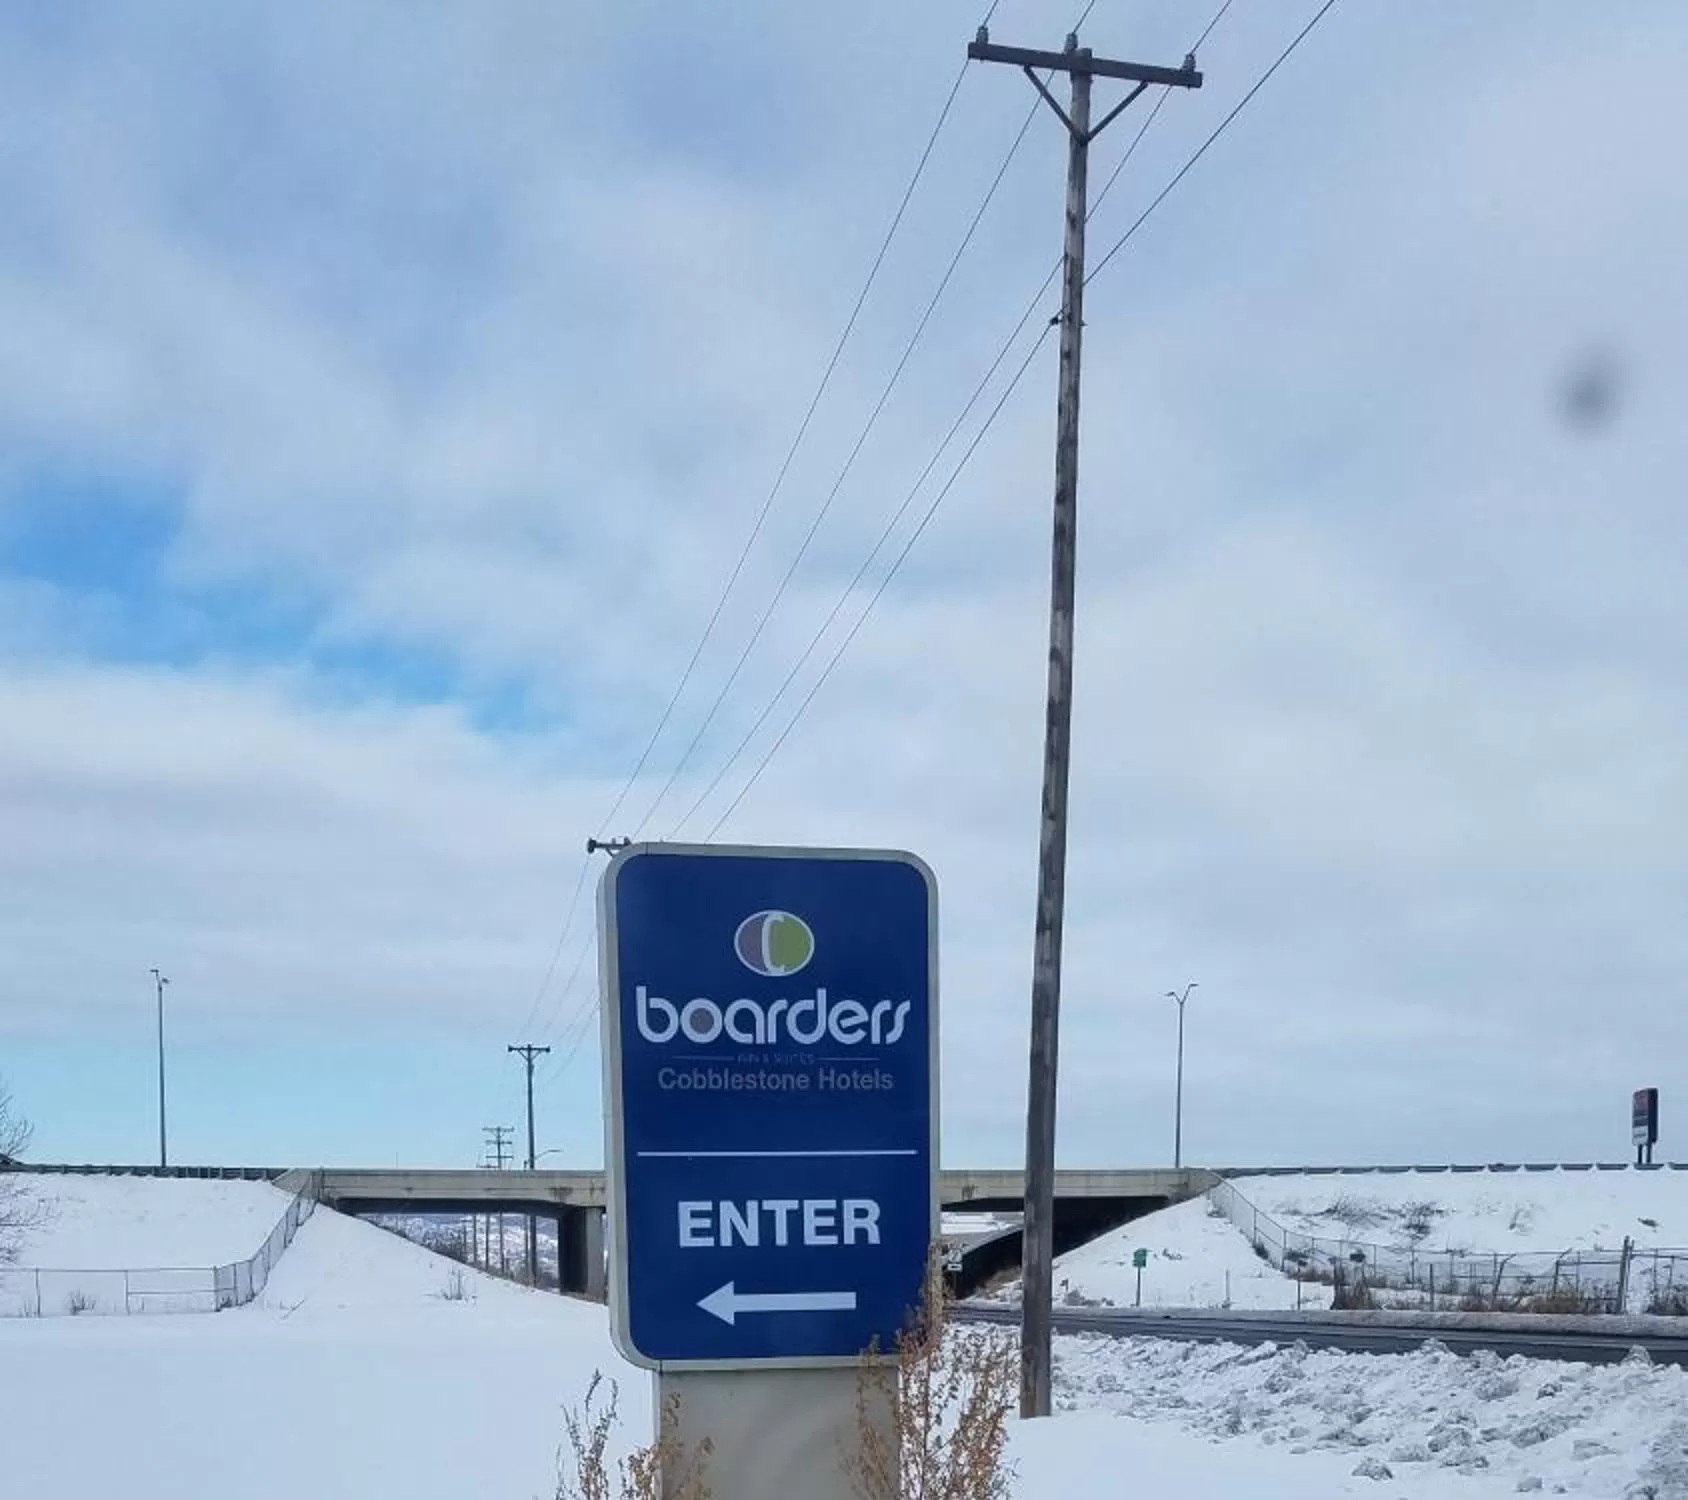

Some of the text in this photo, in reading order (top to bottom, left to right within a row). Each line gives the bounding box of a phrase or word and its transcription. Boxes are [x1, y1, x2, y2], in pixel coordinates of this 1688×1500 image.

[636, 986, 911, 1045] boarders
[658, 1067, 894, 1091] Cobblestone Hotels
[678, 1199, 881, 1247] ENTER
